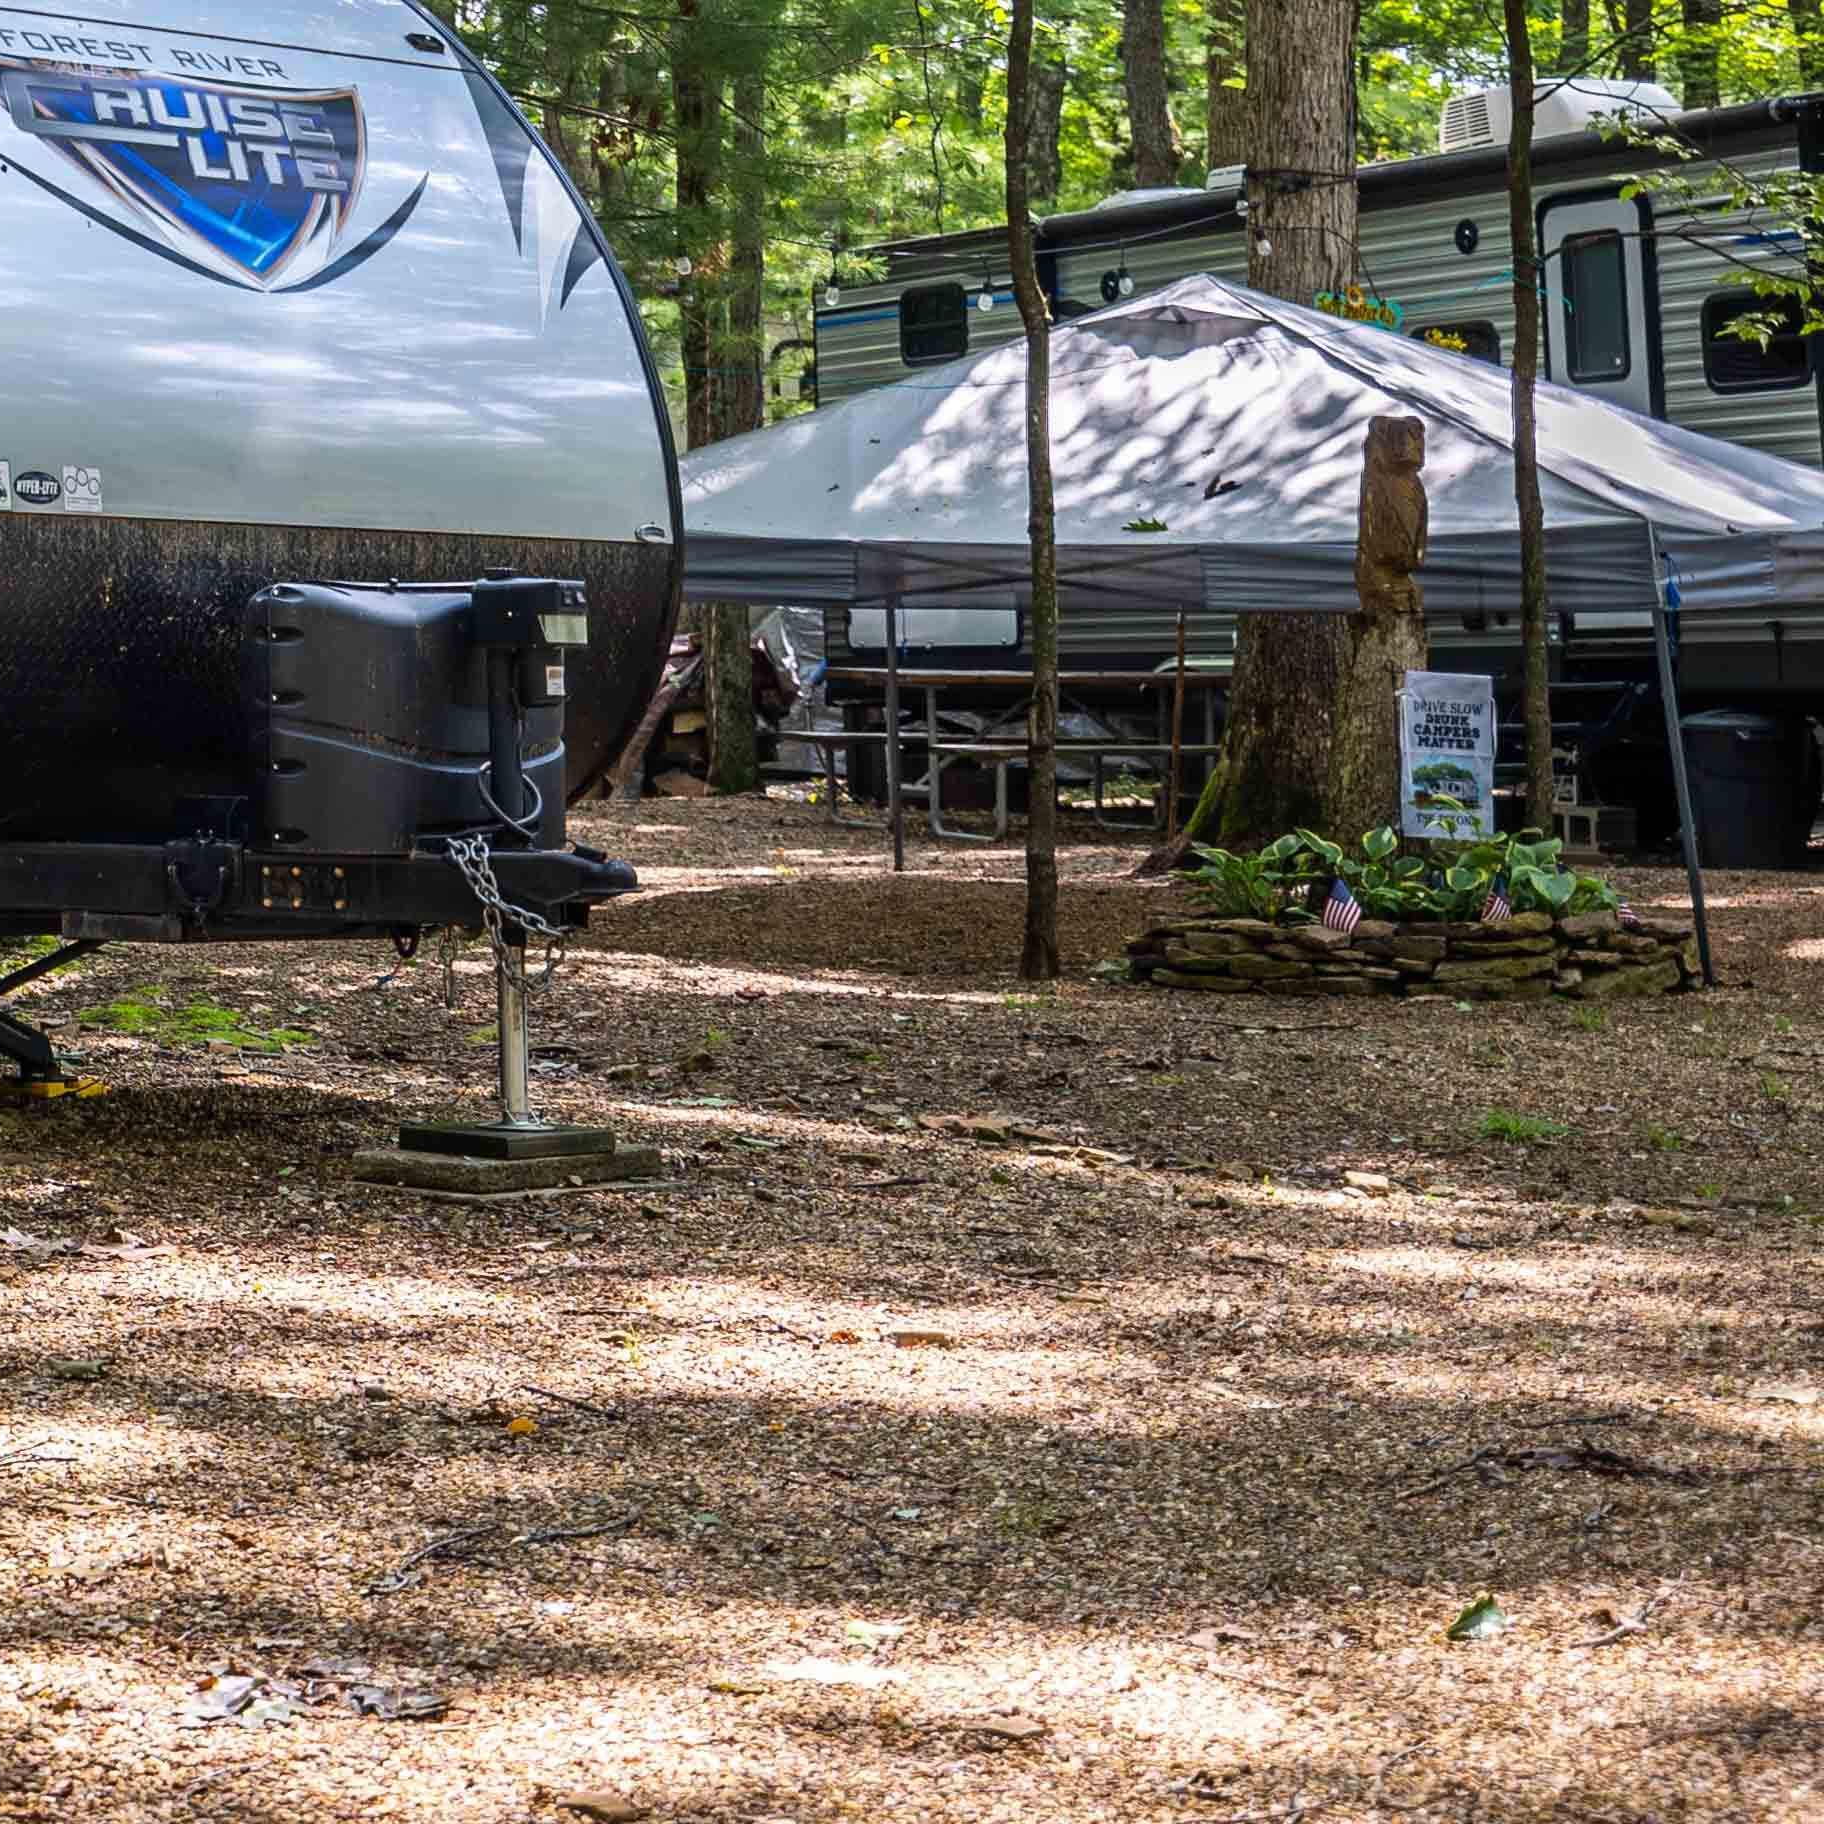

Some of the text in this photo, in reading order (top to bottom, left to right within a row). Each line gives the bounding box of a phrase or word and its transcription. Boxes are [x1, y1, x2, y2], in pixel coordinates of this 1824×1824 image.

[170, 49, 289, 79] RIVER
[3, 70, 336, 147] CRUISE
[178, 133, 351, 192] LITE
[1413, 699, 1483, 716] DRIVE SLOW
[1425, 713, 1470, 726] DRUNK
[1414, 723, 1480, 738] CAMPERS
[1417, 736, 1475, 750] MATTER
